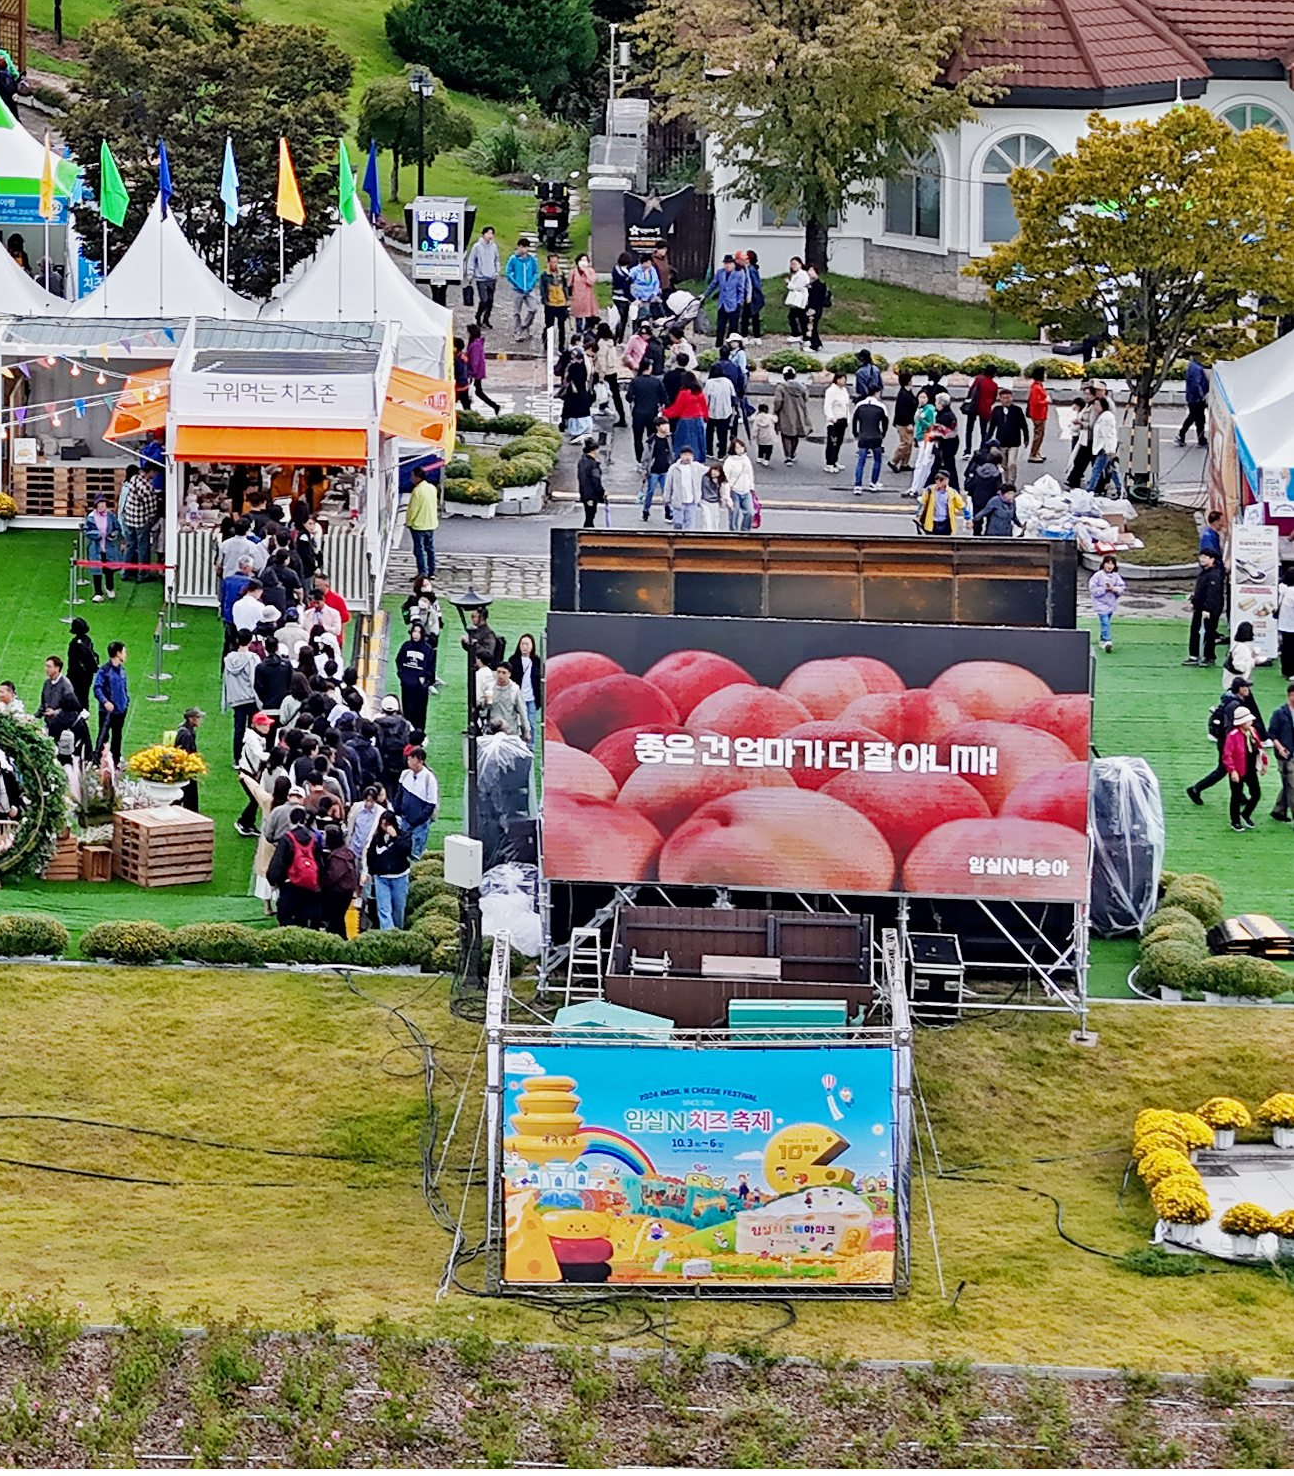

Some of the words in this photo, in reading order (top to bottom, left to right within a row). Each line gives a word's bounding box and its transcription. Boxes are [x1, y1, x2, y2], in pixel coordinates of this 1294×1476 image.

[202, 382, 278, 403] 구워먹는
[281, 383, 338, 404] 치즈존
[634, 733, 696, 765] 좋은
[699, 735, 731, 767] 건
[733, 737, 825, 770] 엄마가
[827, 739, 859, 770] 더
[862, 741, 893, 773] 잘
[896, 743, 998, 776] 아니까!
[968, 855, 1070, 877] 임실N복숭아
[689, 1110, 729, 1132] 치즈
[731, 1110, 771, 1132] 축제
[751, 1222, 837, 1237] 임실치즈테마파크
